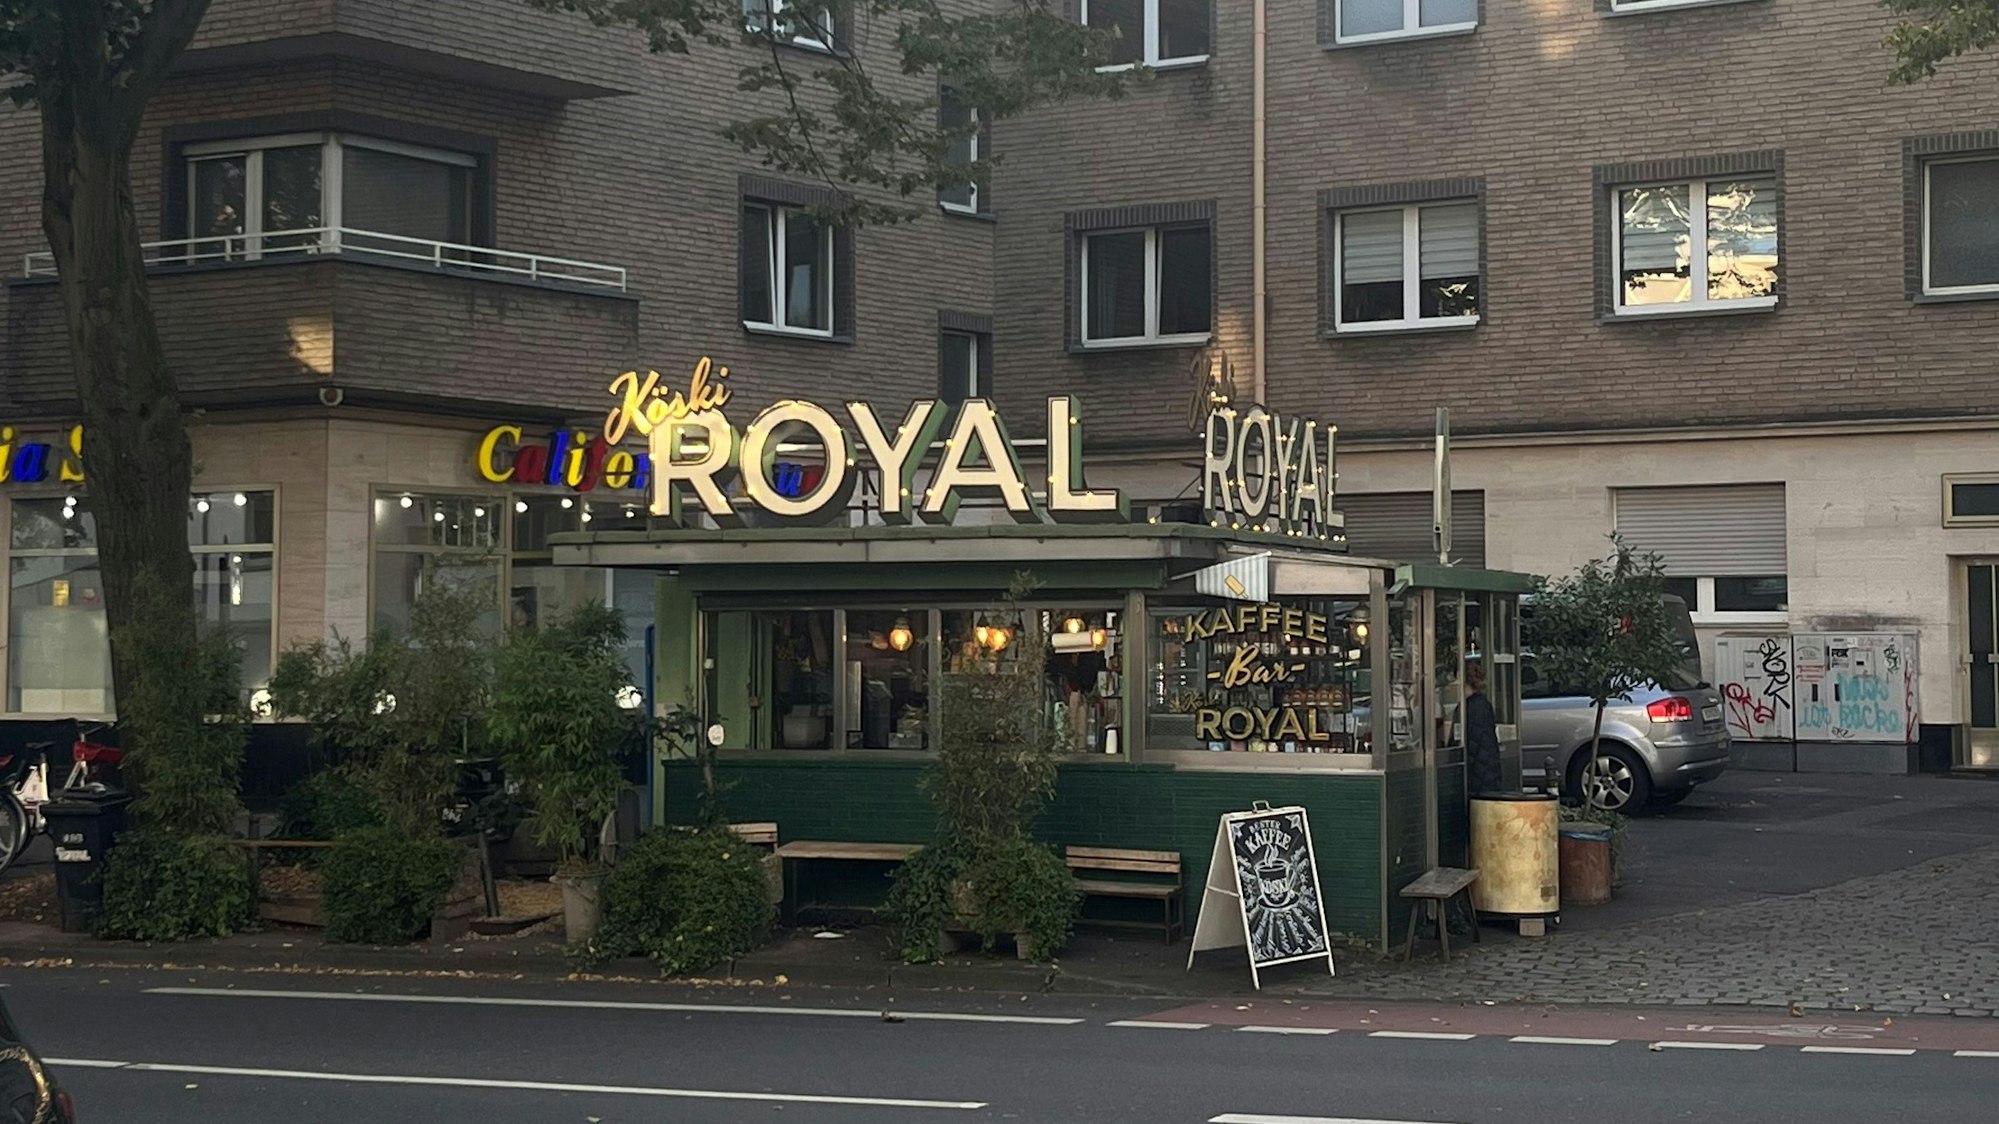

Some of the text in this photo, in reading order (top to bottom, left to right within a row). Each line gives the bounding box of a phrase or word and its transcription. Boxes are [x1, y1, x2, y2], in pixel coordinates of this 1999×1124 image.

[604, 356, 732, 445] Köski
[649, 395, 1122, 519] ROYAL
[1203, 404, 1345, 528] ROYAL
[1185, 604, 1328, 643] KAFFEE
[1196, 706, 1330, 742] ROYAL
[1244, 829, 1292, 854] KAFFEE
